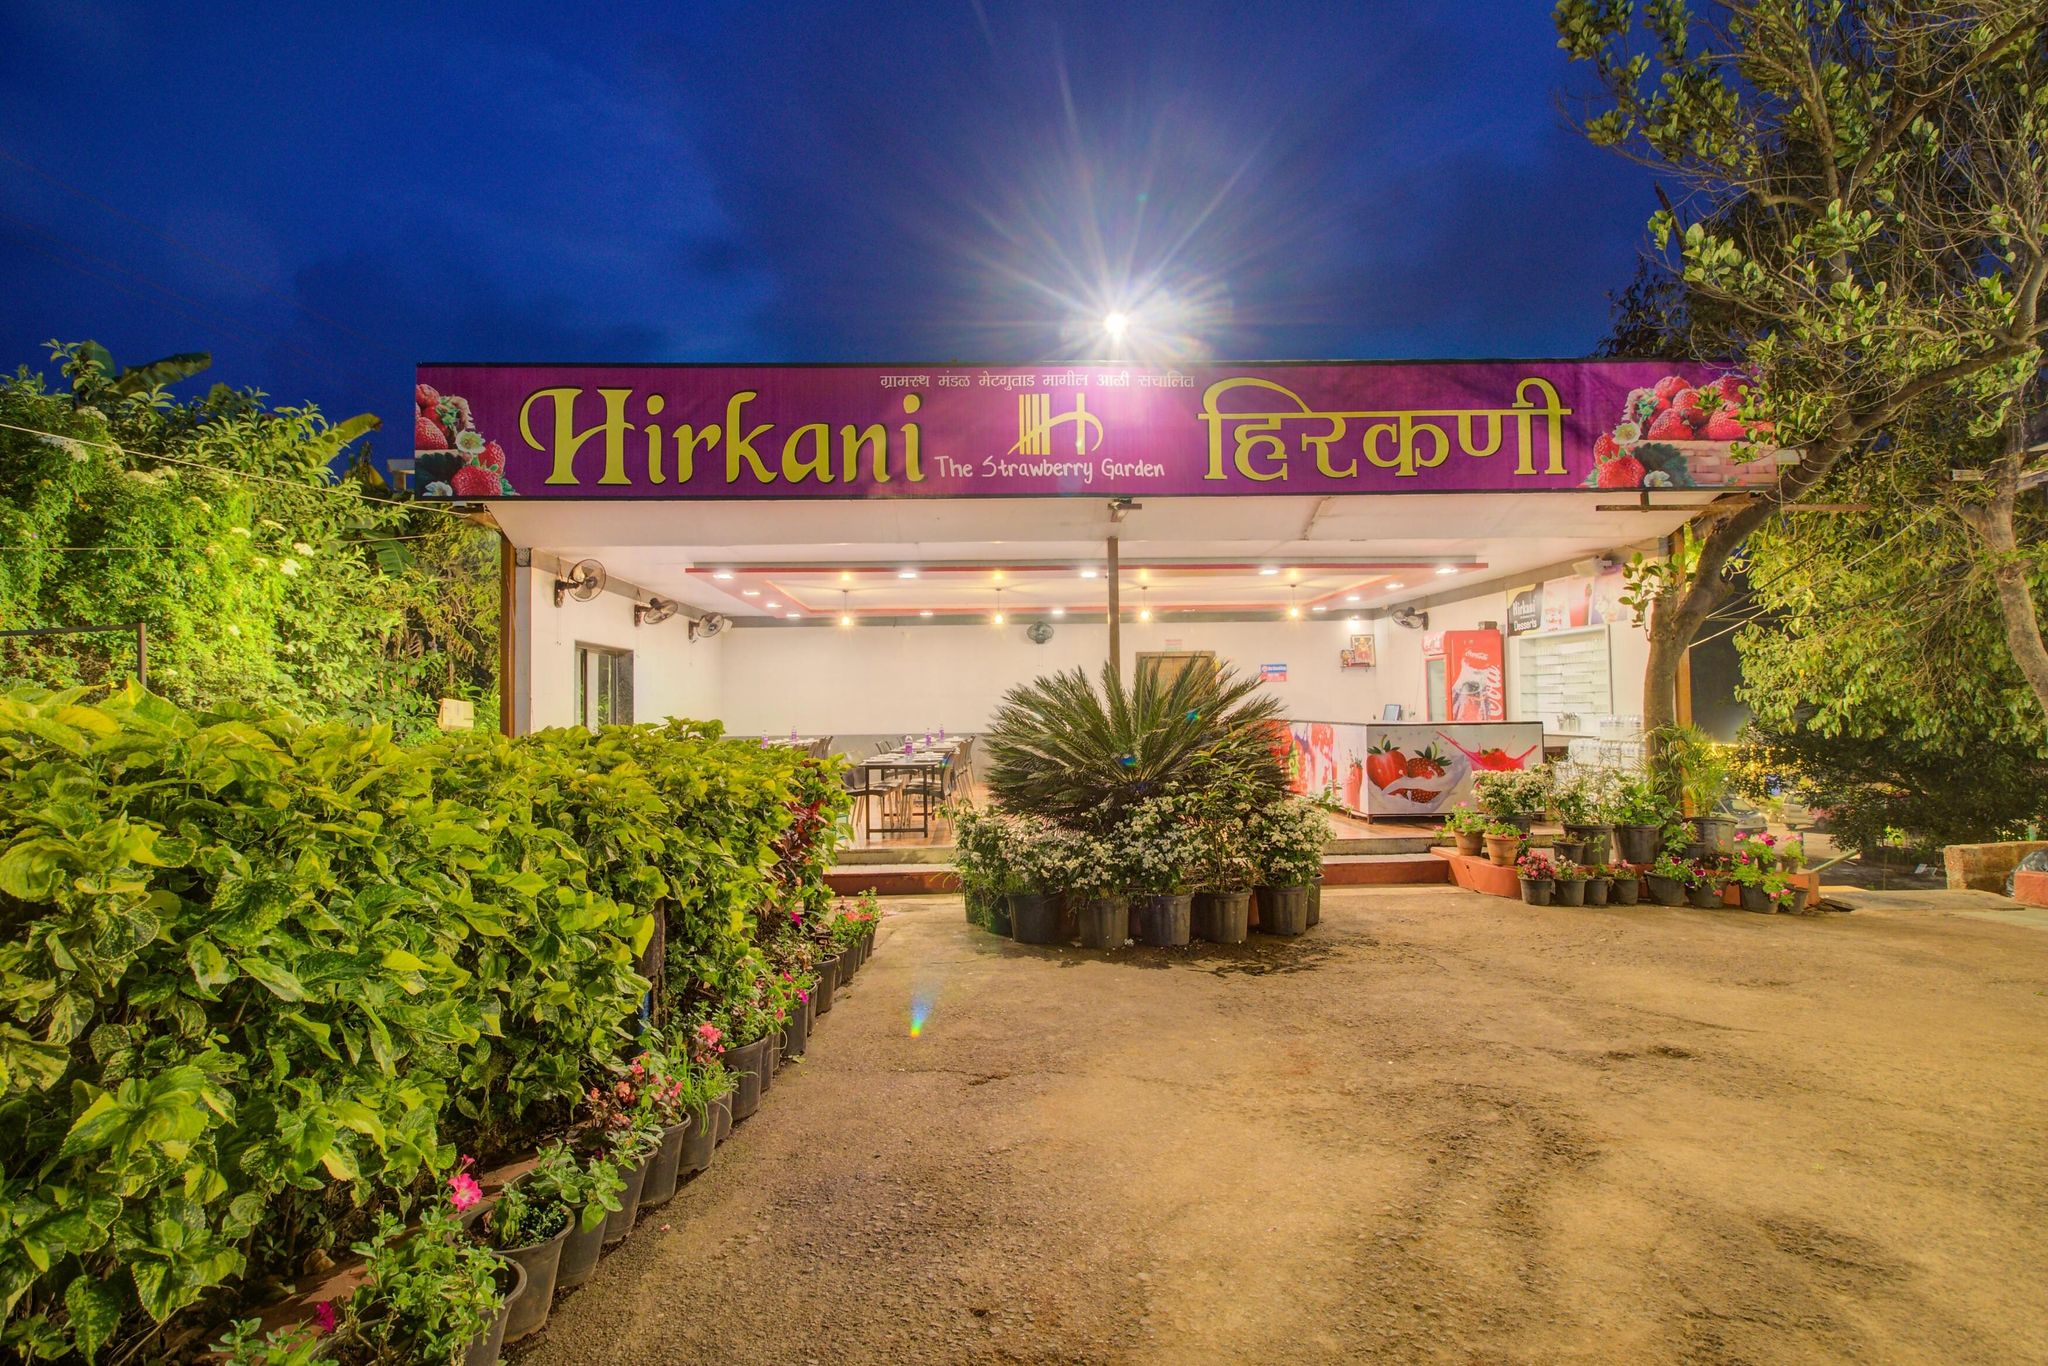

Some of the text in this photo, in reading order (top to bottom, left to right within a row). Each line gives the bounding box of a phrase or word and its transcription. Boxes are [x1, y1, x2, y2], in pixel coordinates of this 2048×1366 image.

[880, 374, 930, 389] ग्रामस्थ
[937, 370, 970, 388] मंडळ
[1042, 370, 1088, 387] मागील
[1096, 371, 1129, 387] आळी
[519, 386, 924, 484] Hirkani
[1198, 378, 1572, 482] हिरकणी
[934, 456, 1165, 483] The Strawberry Garden
